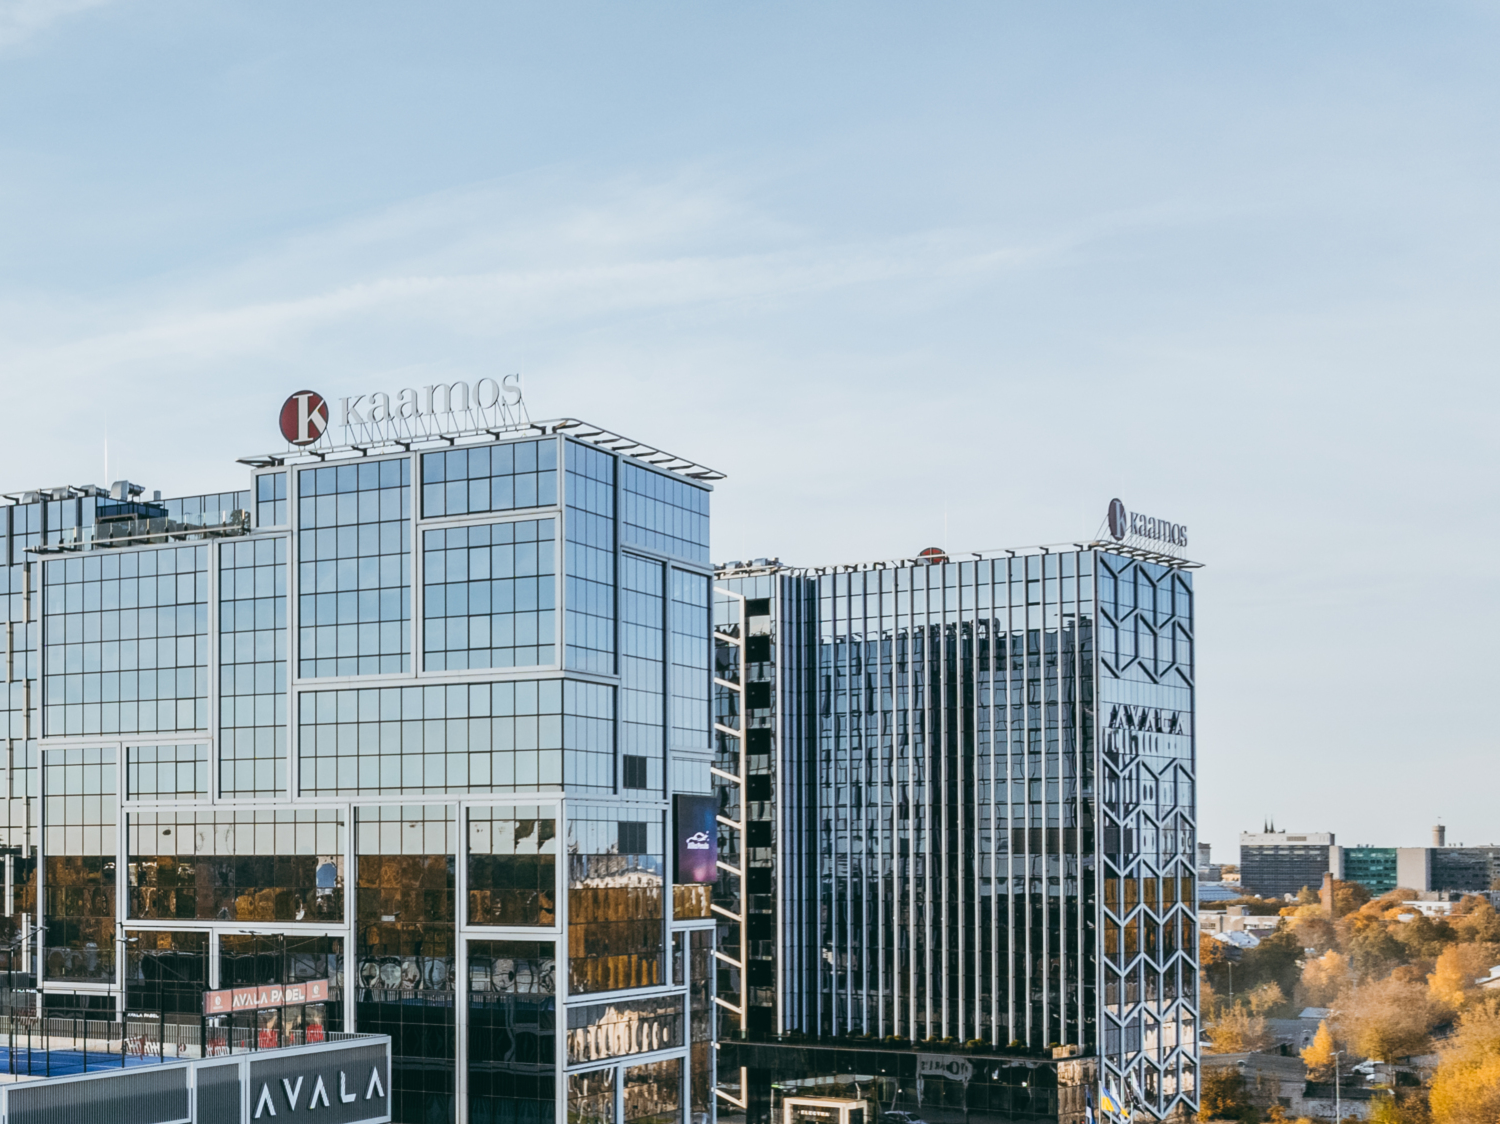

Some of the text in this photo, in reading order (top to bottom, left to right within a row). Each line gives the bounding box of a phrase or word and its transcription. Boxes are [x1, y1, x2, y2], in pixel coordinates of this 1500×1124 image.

[338, 373, 522, 427] kaamos
[1130, 511, 1187, 547] kaamos
[232, 987, 305, 1008] AVALA PADEL
[254, 1065, 385, 1119] AVALA
